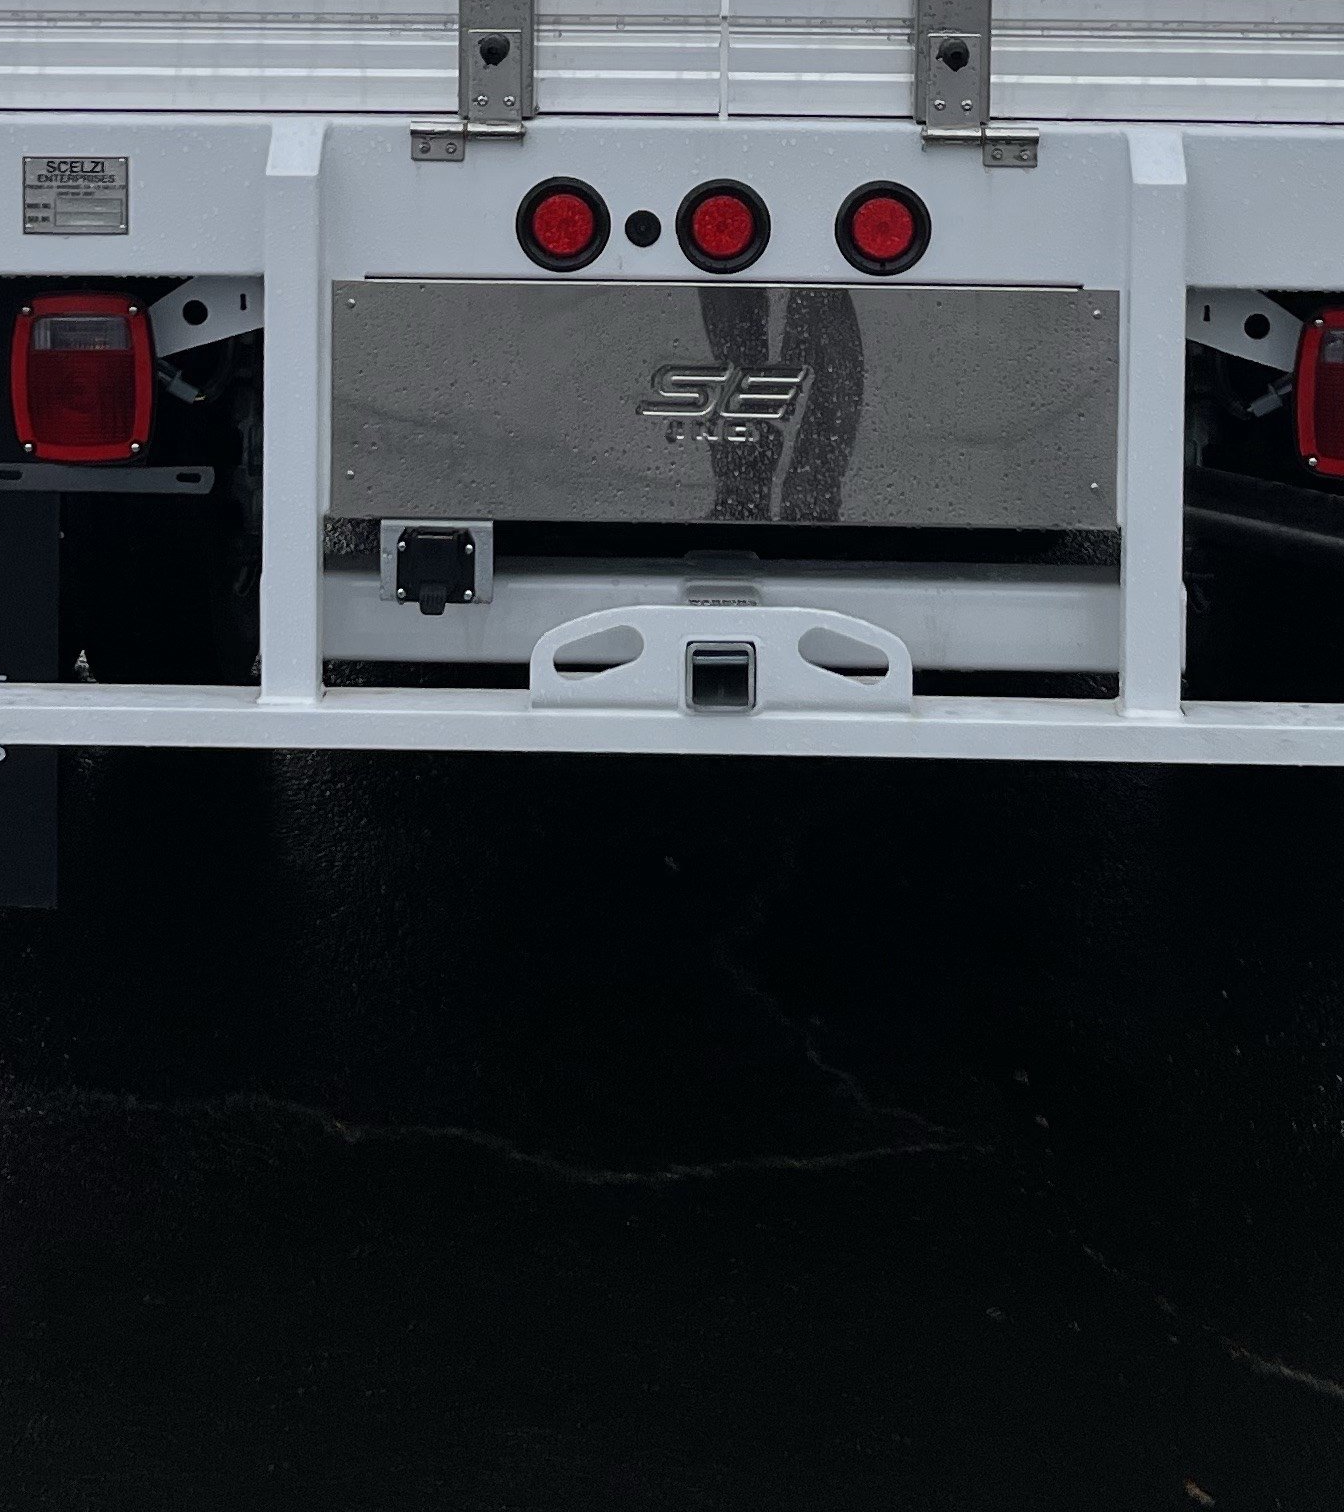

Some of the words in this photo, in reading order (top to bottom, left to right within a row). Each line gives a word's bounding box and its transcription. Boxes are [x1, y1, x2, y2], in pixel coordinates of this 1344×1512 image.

[46, 160, 106, 174] SCELZI
[36, 173, 117, 184] ENTERPRISES
[636, 365, 813, 419] SE
